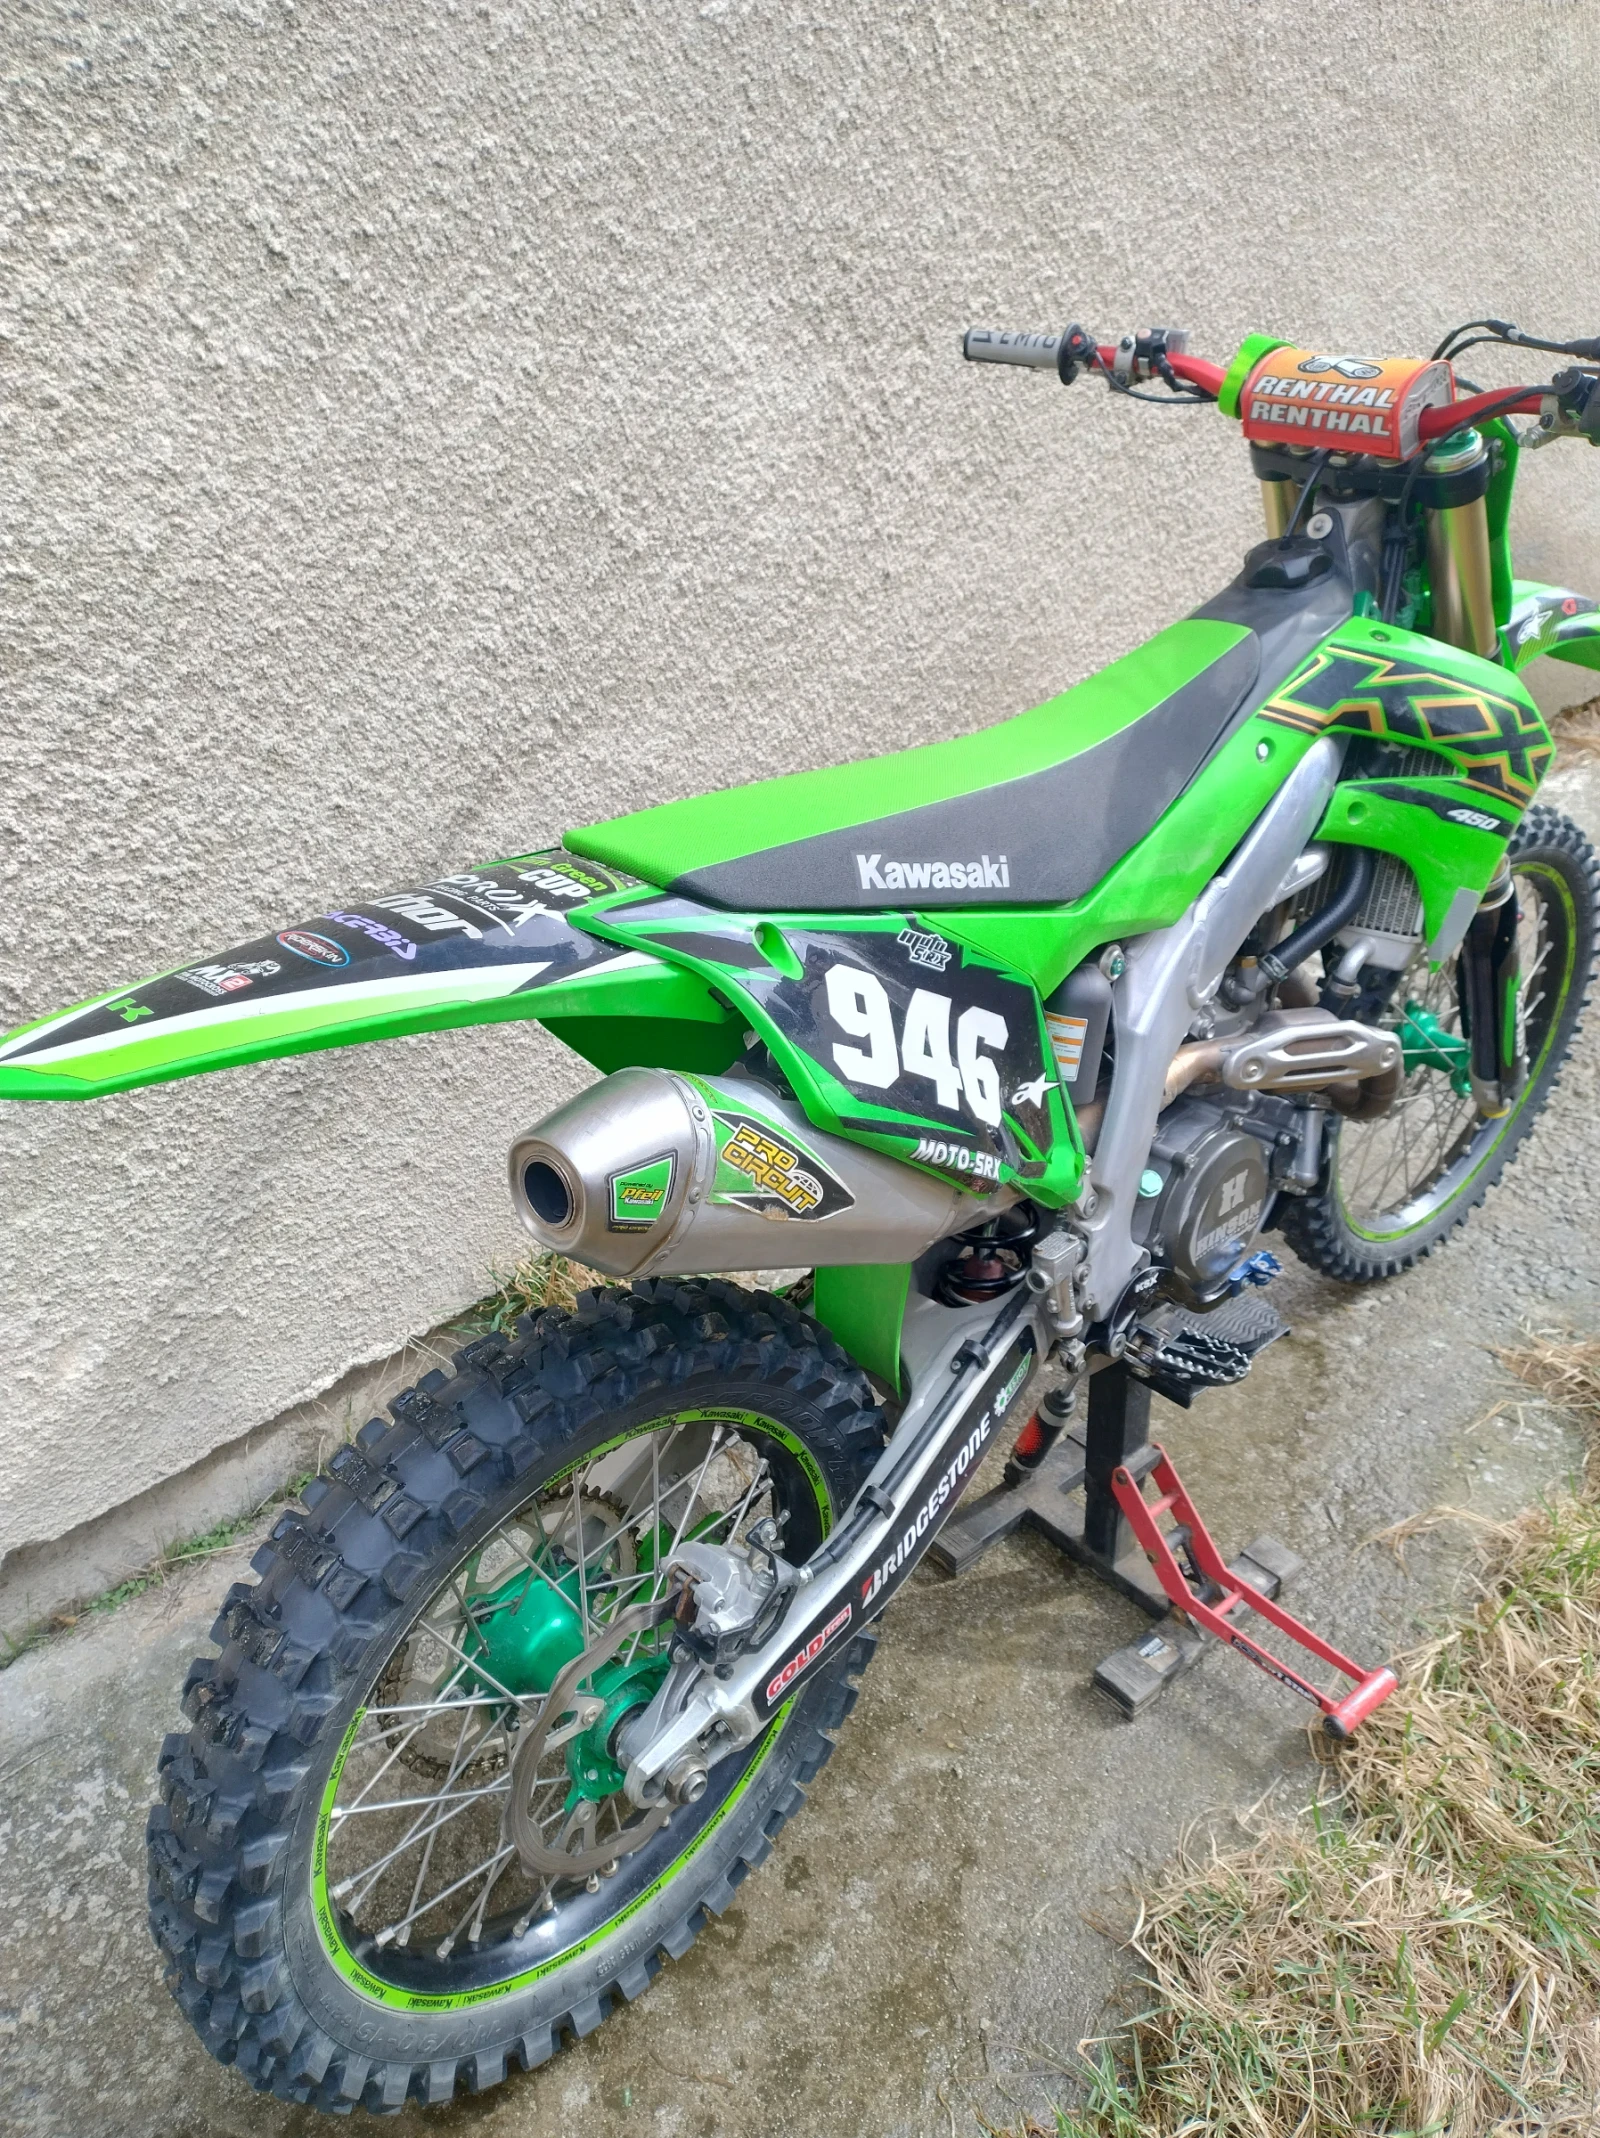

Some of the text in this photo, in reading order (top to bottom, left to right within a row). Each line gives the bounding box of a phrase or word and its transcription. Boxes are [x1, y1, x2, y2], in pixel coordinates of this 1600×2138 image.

[1252, 375, 1396, 409] RENTHAL
[1250, 401, 1391, 437] RENTHAL
[1446, 808, 1501, 831] 450
[518, 869, 592, 898] CUP
[550, 863, 608, 891] Green
[856, 853, 1011, 890] Kawasaki
[466, 895, 501, 912] PARTS
[825, 963, 1010, 1128] 946
[734, 1125, 797, 1172] PRO
[909, 1137, 1002, 1180] MOTO-SRX
[619, 1187, 665, 1201] Pfeil
[721, 1142, 818, 1210] CIRCUIT
[701, 1409, 743, 1421] Kawasaki
[753, 1417, 790, 1441] Kawasaki
[799, 1450, 822, 1487] Kawasaki
[861, 1411, 991, 1610] BRIDGESTONE
[328, 1709, 365, 1781] Kawasaki
[313, 1811, 329, 1878] Kawasaki
[614, 1882, 663, 1928] Kawasaki
[316, 1904, 341, 1957] Kawasaki
[535, 1943, 587, 1980] Kawasaki
[348, 1967, 388, 2001] Kawasaki
[462, 1983, 513, 2002] Kawasaki
[405, 1996, 454, 2010] Kawasaki
